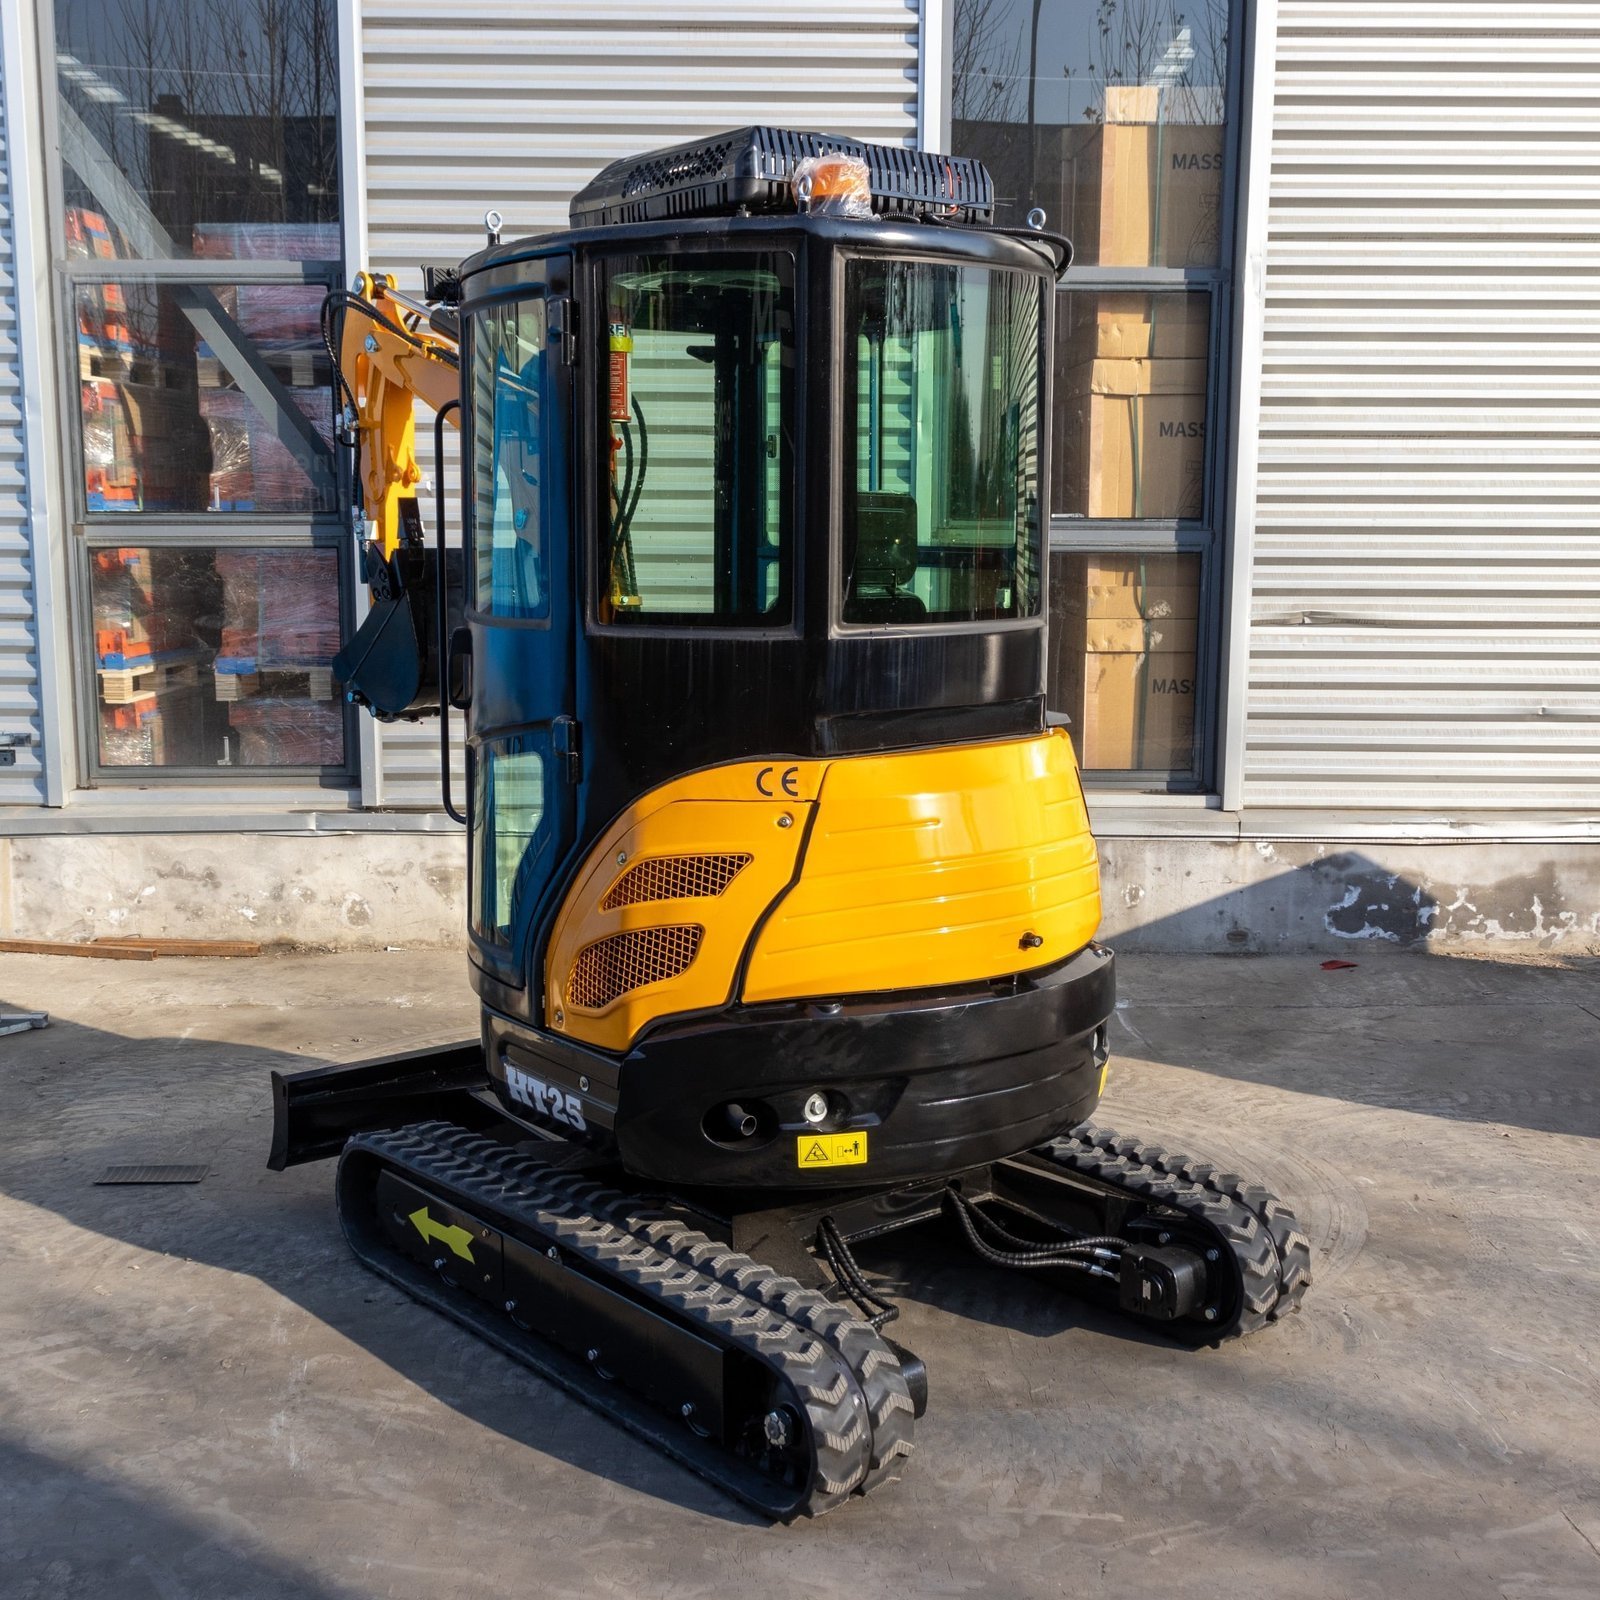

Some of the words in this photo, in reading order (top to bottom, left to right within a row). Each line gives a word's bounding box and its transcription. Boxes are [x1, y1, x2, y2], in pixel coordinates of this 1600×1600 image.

[1152, 679, 1194, 694] MAS
[756, 766, 799, 797] CE
[503, 1062, 587, 1131] HT25
